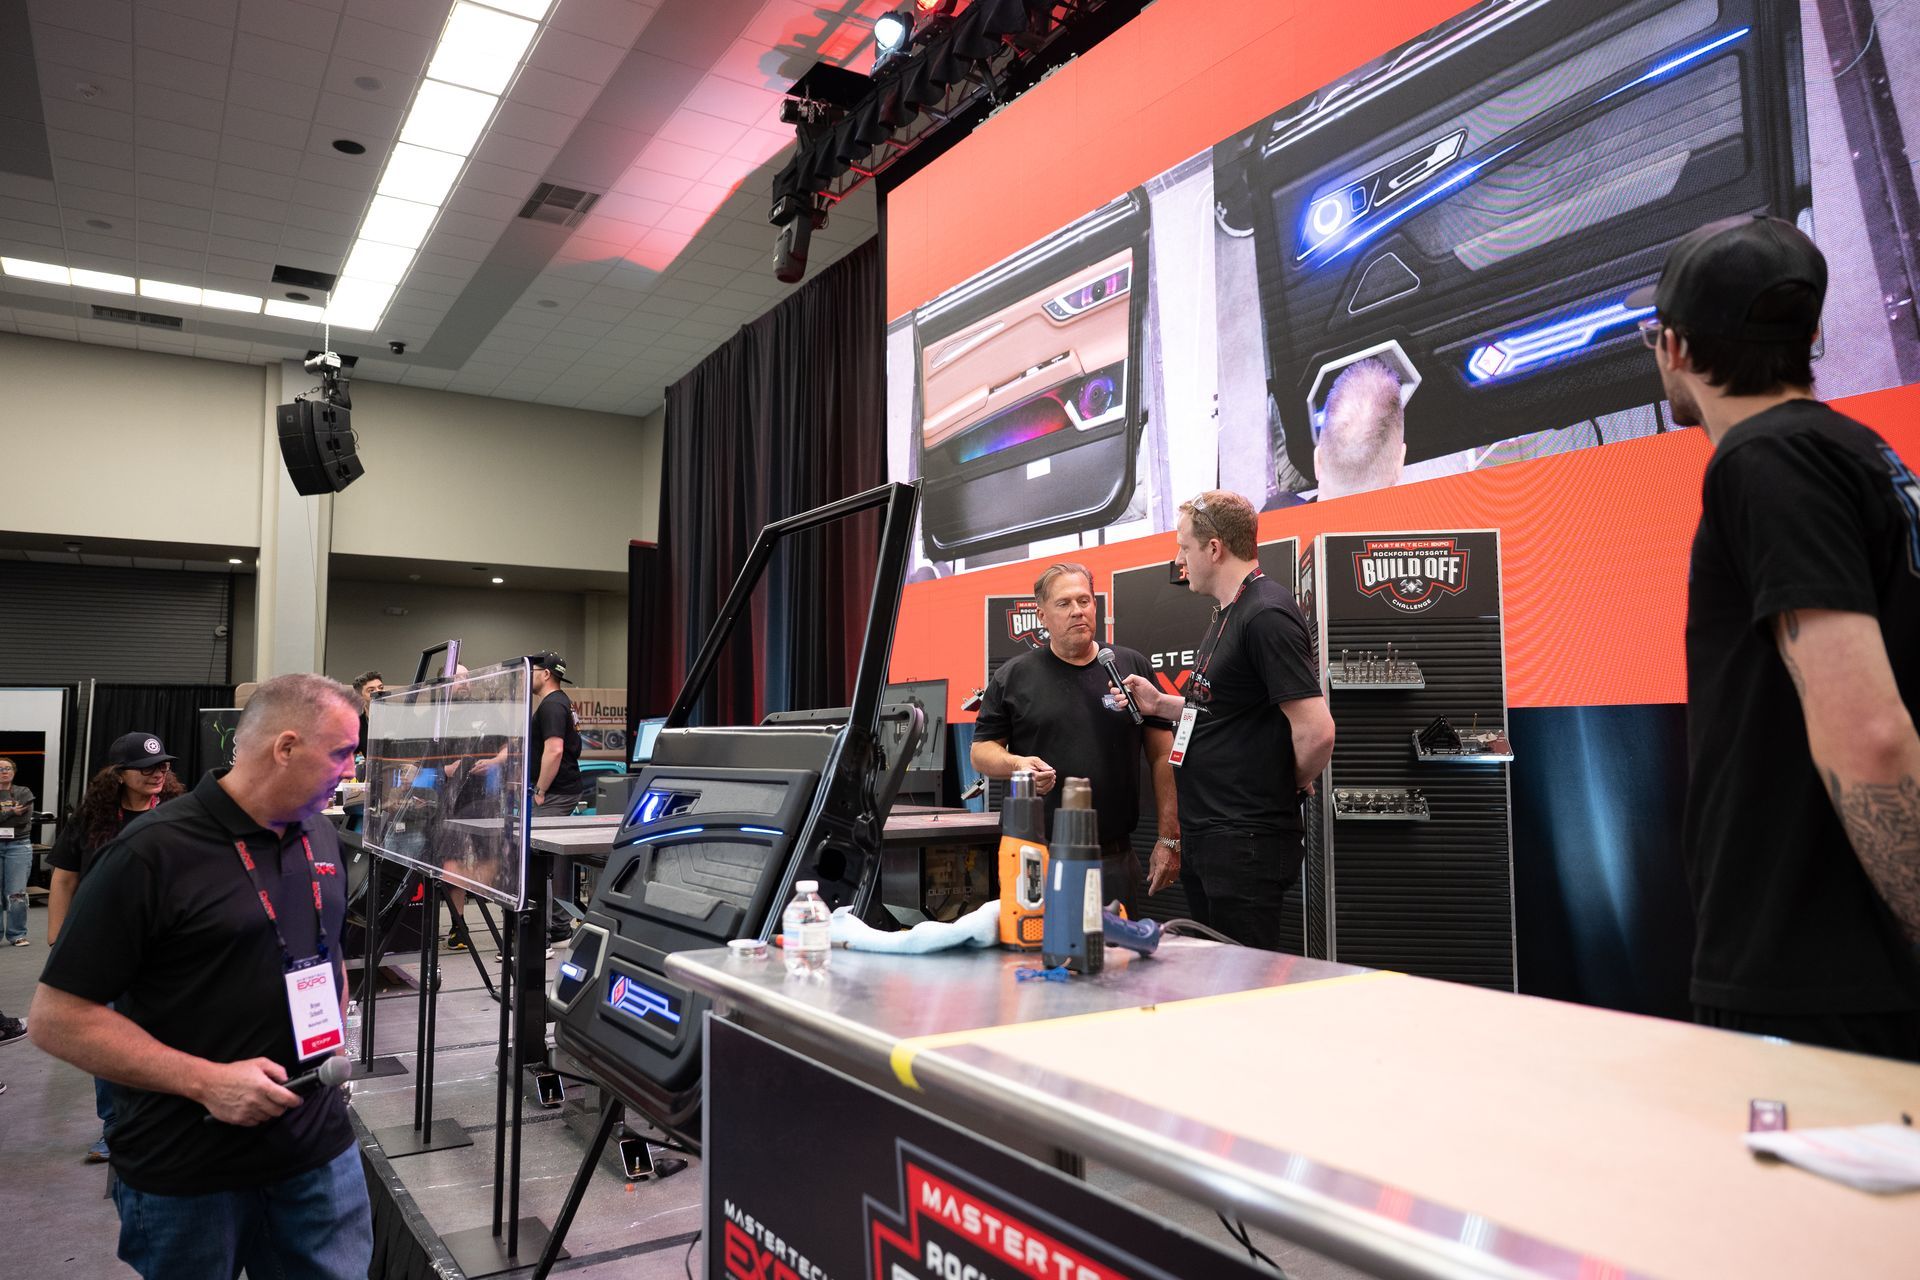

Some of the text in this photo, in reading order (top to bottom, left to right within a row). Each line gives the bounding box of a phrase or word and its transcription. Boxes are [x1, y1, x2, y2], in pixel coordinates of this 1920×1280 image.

[1361, 556, 1460, 587] BUILD OFF
[1392, 598, 1432, 610] CHALLENGE
[1012, 614, 1044, 635] BUIL
[1150, 650, 1196, 668] STE
[297, 976, 326, 991] EXPO
[724, 1198, 836, 1280] MASTERTEC
[926, 1240, 1001, 1280] ROC
